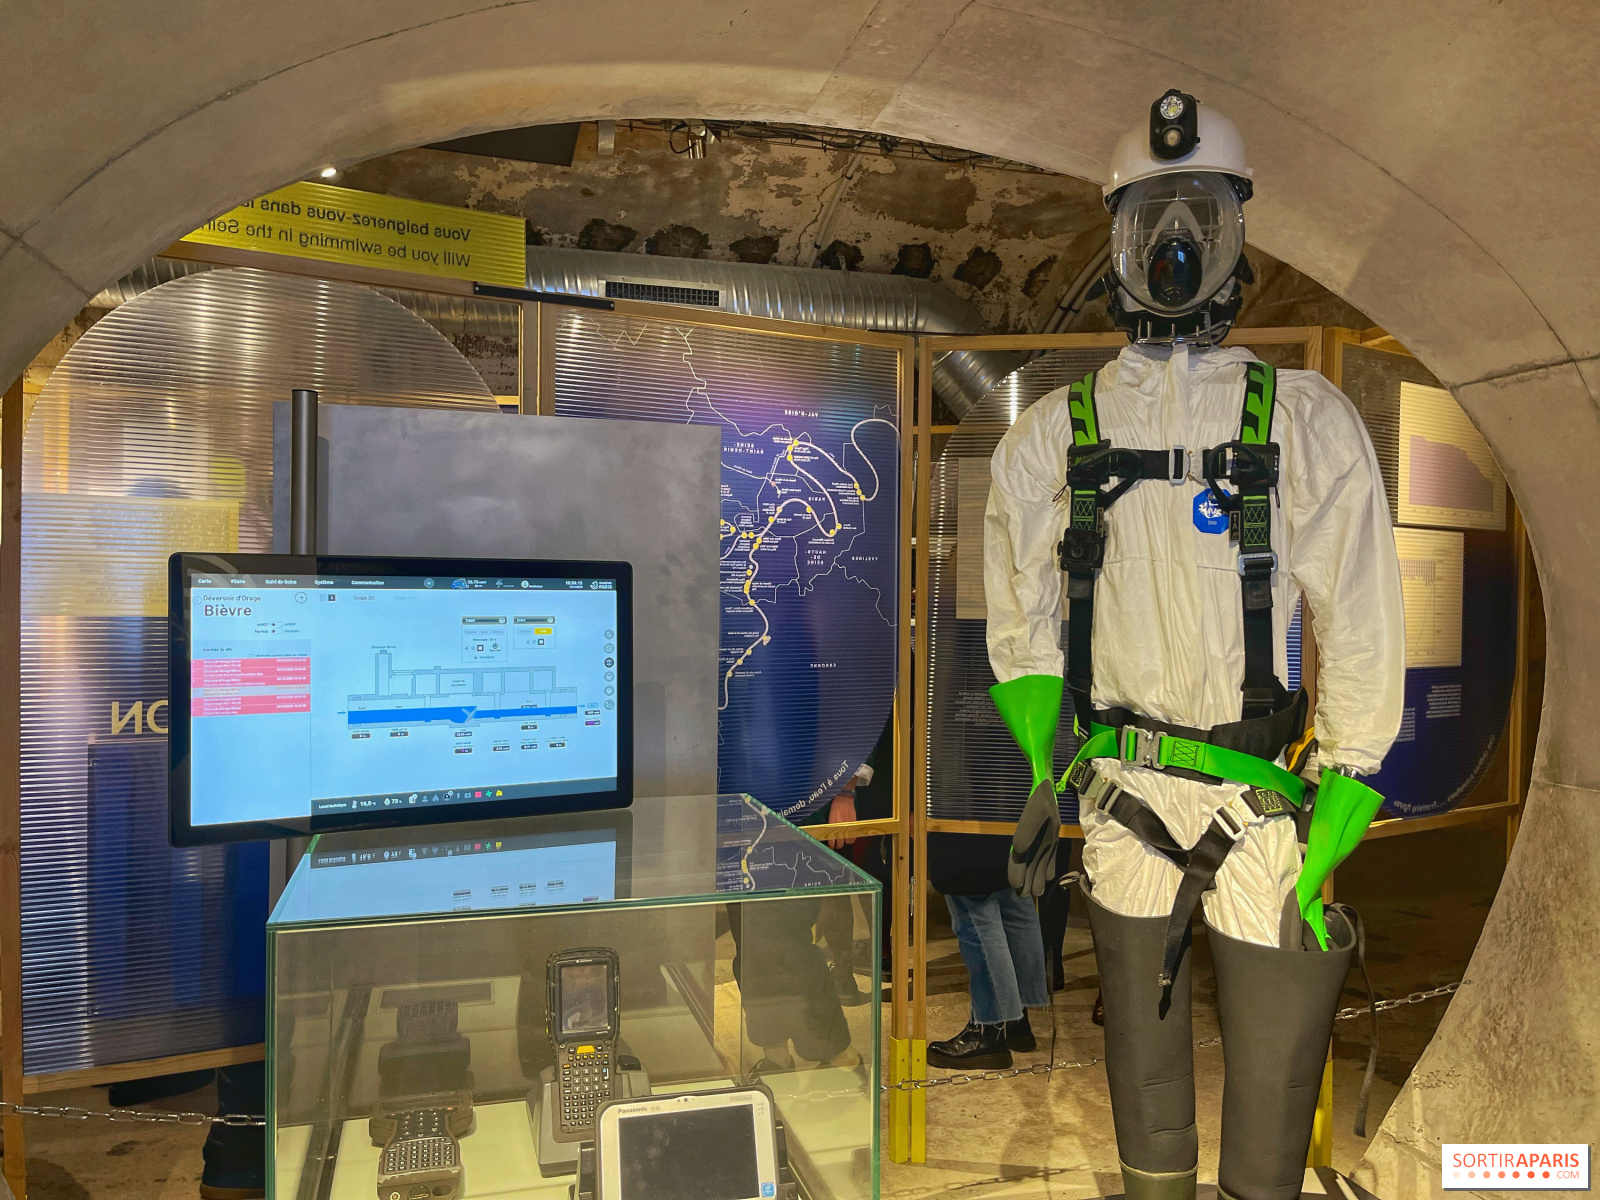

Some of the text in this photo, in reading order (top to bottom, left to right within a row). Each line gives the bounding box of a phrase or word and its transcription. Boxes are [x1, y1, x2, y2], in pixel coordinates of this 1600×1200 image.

[236, 595, 262, 603] d'Orage
[204, 603, 252, 617] Bièvre
[617, 1105, 648, 1114] Panasonic
